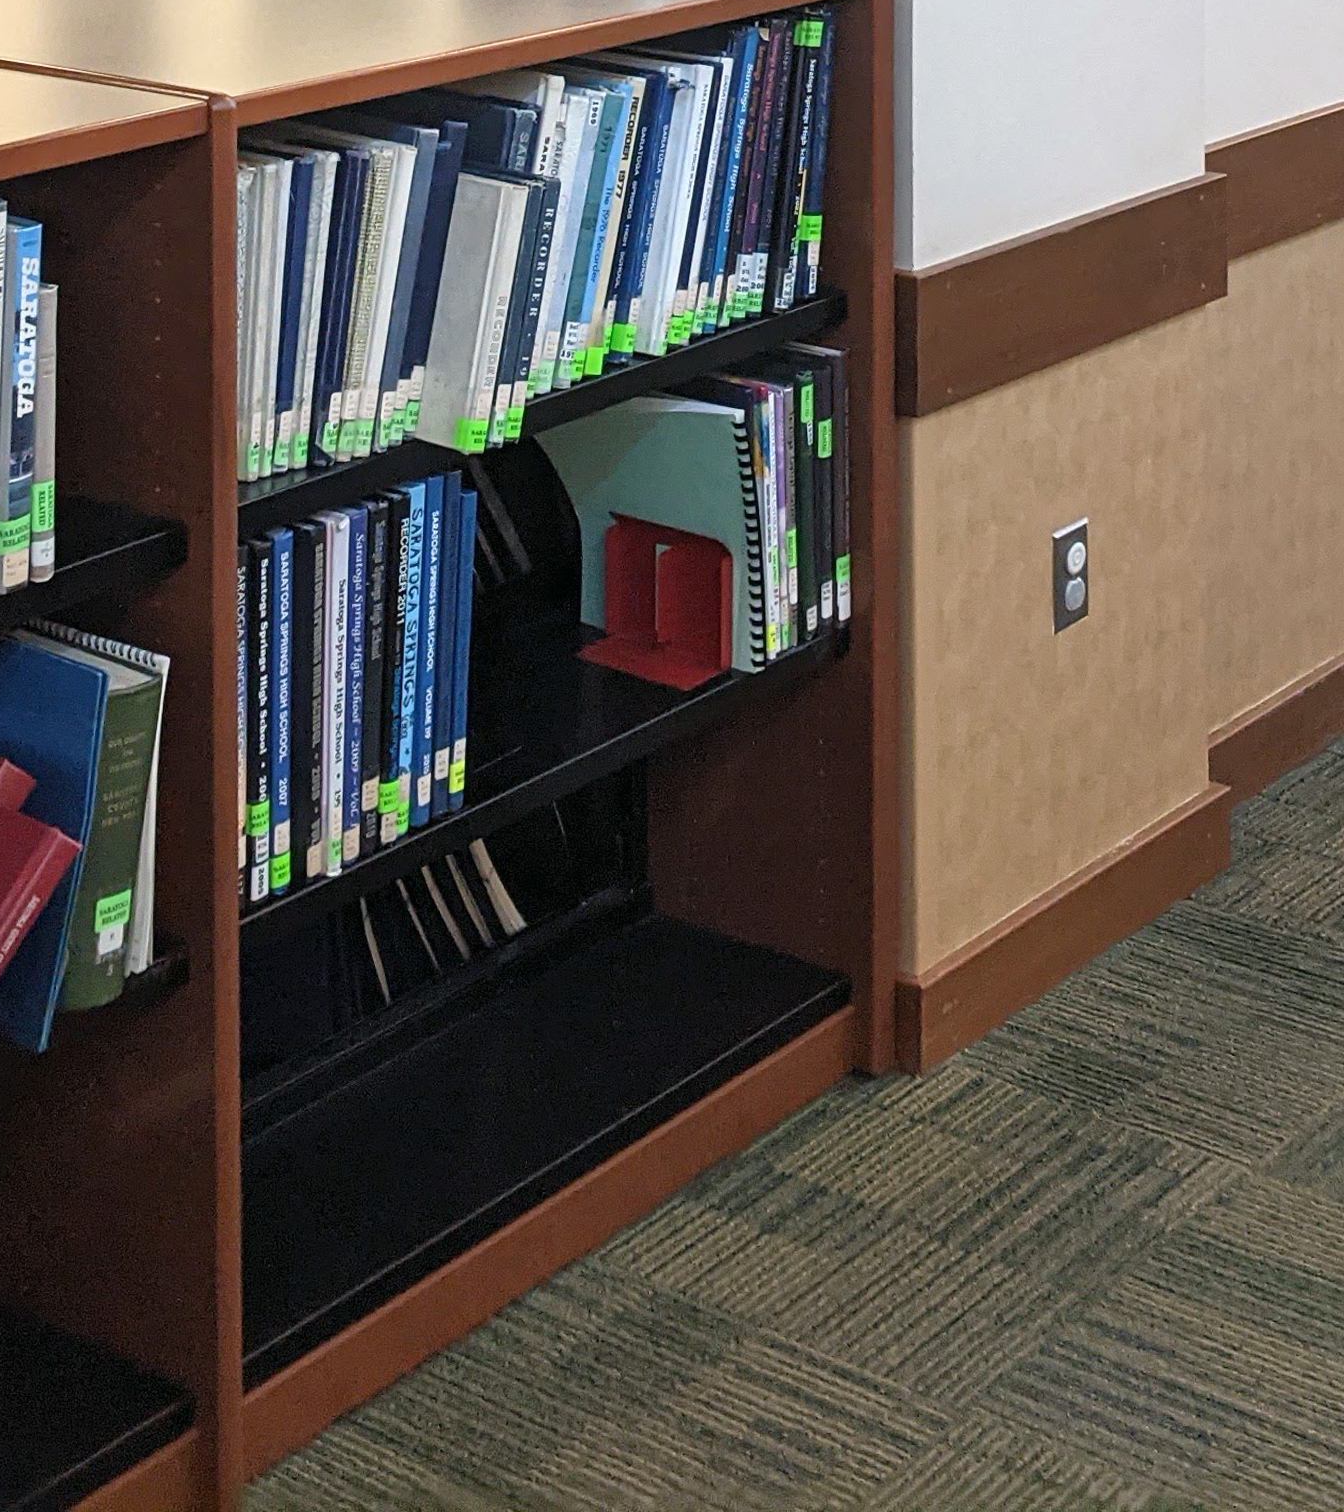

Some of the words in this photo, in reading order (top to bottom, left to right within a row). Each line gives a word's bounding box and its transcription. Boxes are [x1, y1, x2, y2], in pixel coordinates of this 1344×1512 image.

[739, 62, 755, 113] Saratoga
[621, 96, 641, 162] RECORDER
[634, 125, 648, 177] SARATOGA
[655, 124, 669, 175] SARATOGA
[733, 117, 747, 160] Springs
[605, 187, 613, 206] The
[615, 169, 627, 200] 1977
[648, 178, 661, 220] SPRINGS
[729, 163, 740, 191] High
[626, 180, 638, 221] SPRINGS
[723, 195, 736, 233] School
[621, 223, 631, 248] HIGH
[644, 222, 653, 246] HIGH
[529, 207, 555, 318] RECORDER
[589, 234, 606, 284] Recorder
[613, 250, 626, 290] SCHOOL
[637, 251, 649, 289] SCHOOL
[16, 256, 42, 419] SARATOGA
[483, 295, 508, 388] RECORDER
[37, 489, 47, 527] RELATED
[397, 517, 410, 593] RECORDER
[407, 505, 424, 614] SARATOGA
[429, 510, 440, 565] SARATOGA
[351, 532, 365, 593] Saratoga
[428, 564, 439, 605] SPRINGS
[236, 565, 247, 639] SARATOGA
[258, 557, 270, 619] Saratoga
[279, 550, 291, 621] SARATOGA
[337, 578, 348, 634] Saratoga
[351, 595, 364, 642] Springs
[395, 594, 407, 625] 2011
[427, 604, 436, 629] HIGH
[258, 620, 269, 673] Springs
[278, 621, 291, 677] SPRINGS
[334, 633, 346, 685] Springs
[349, 643, 363, 678] High
[402, 618, 419, 709] SPRINGS
[425, 629, 435, 673] SCHOOL
[258, 674, 269, 708] High
[278, 679, 290, 711] HIGH
[334, 687, 346, 719] High
[350, 680, 363, 725] School
[423, 685, 433, 724] VOLUME
[258, 709, 269, 756] School
[278, 711, 289, 764] SCHOOL
[335, 722, 344, 766] School
[277, 777, 288, 807] 2007
